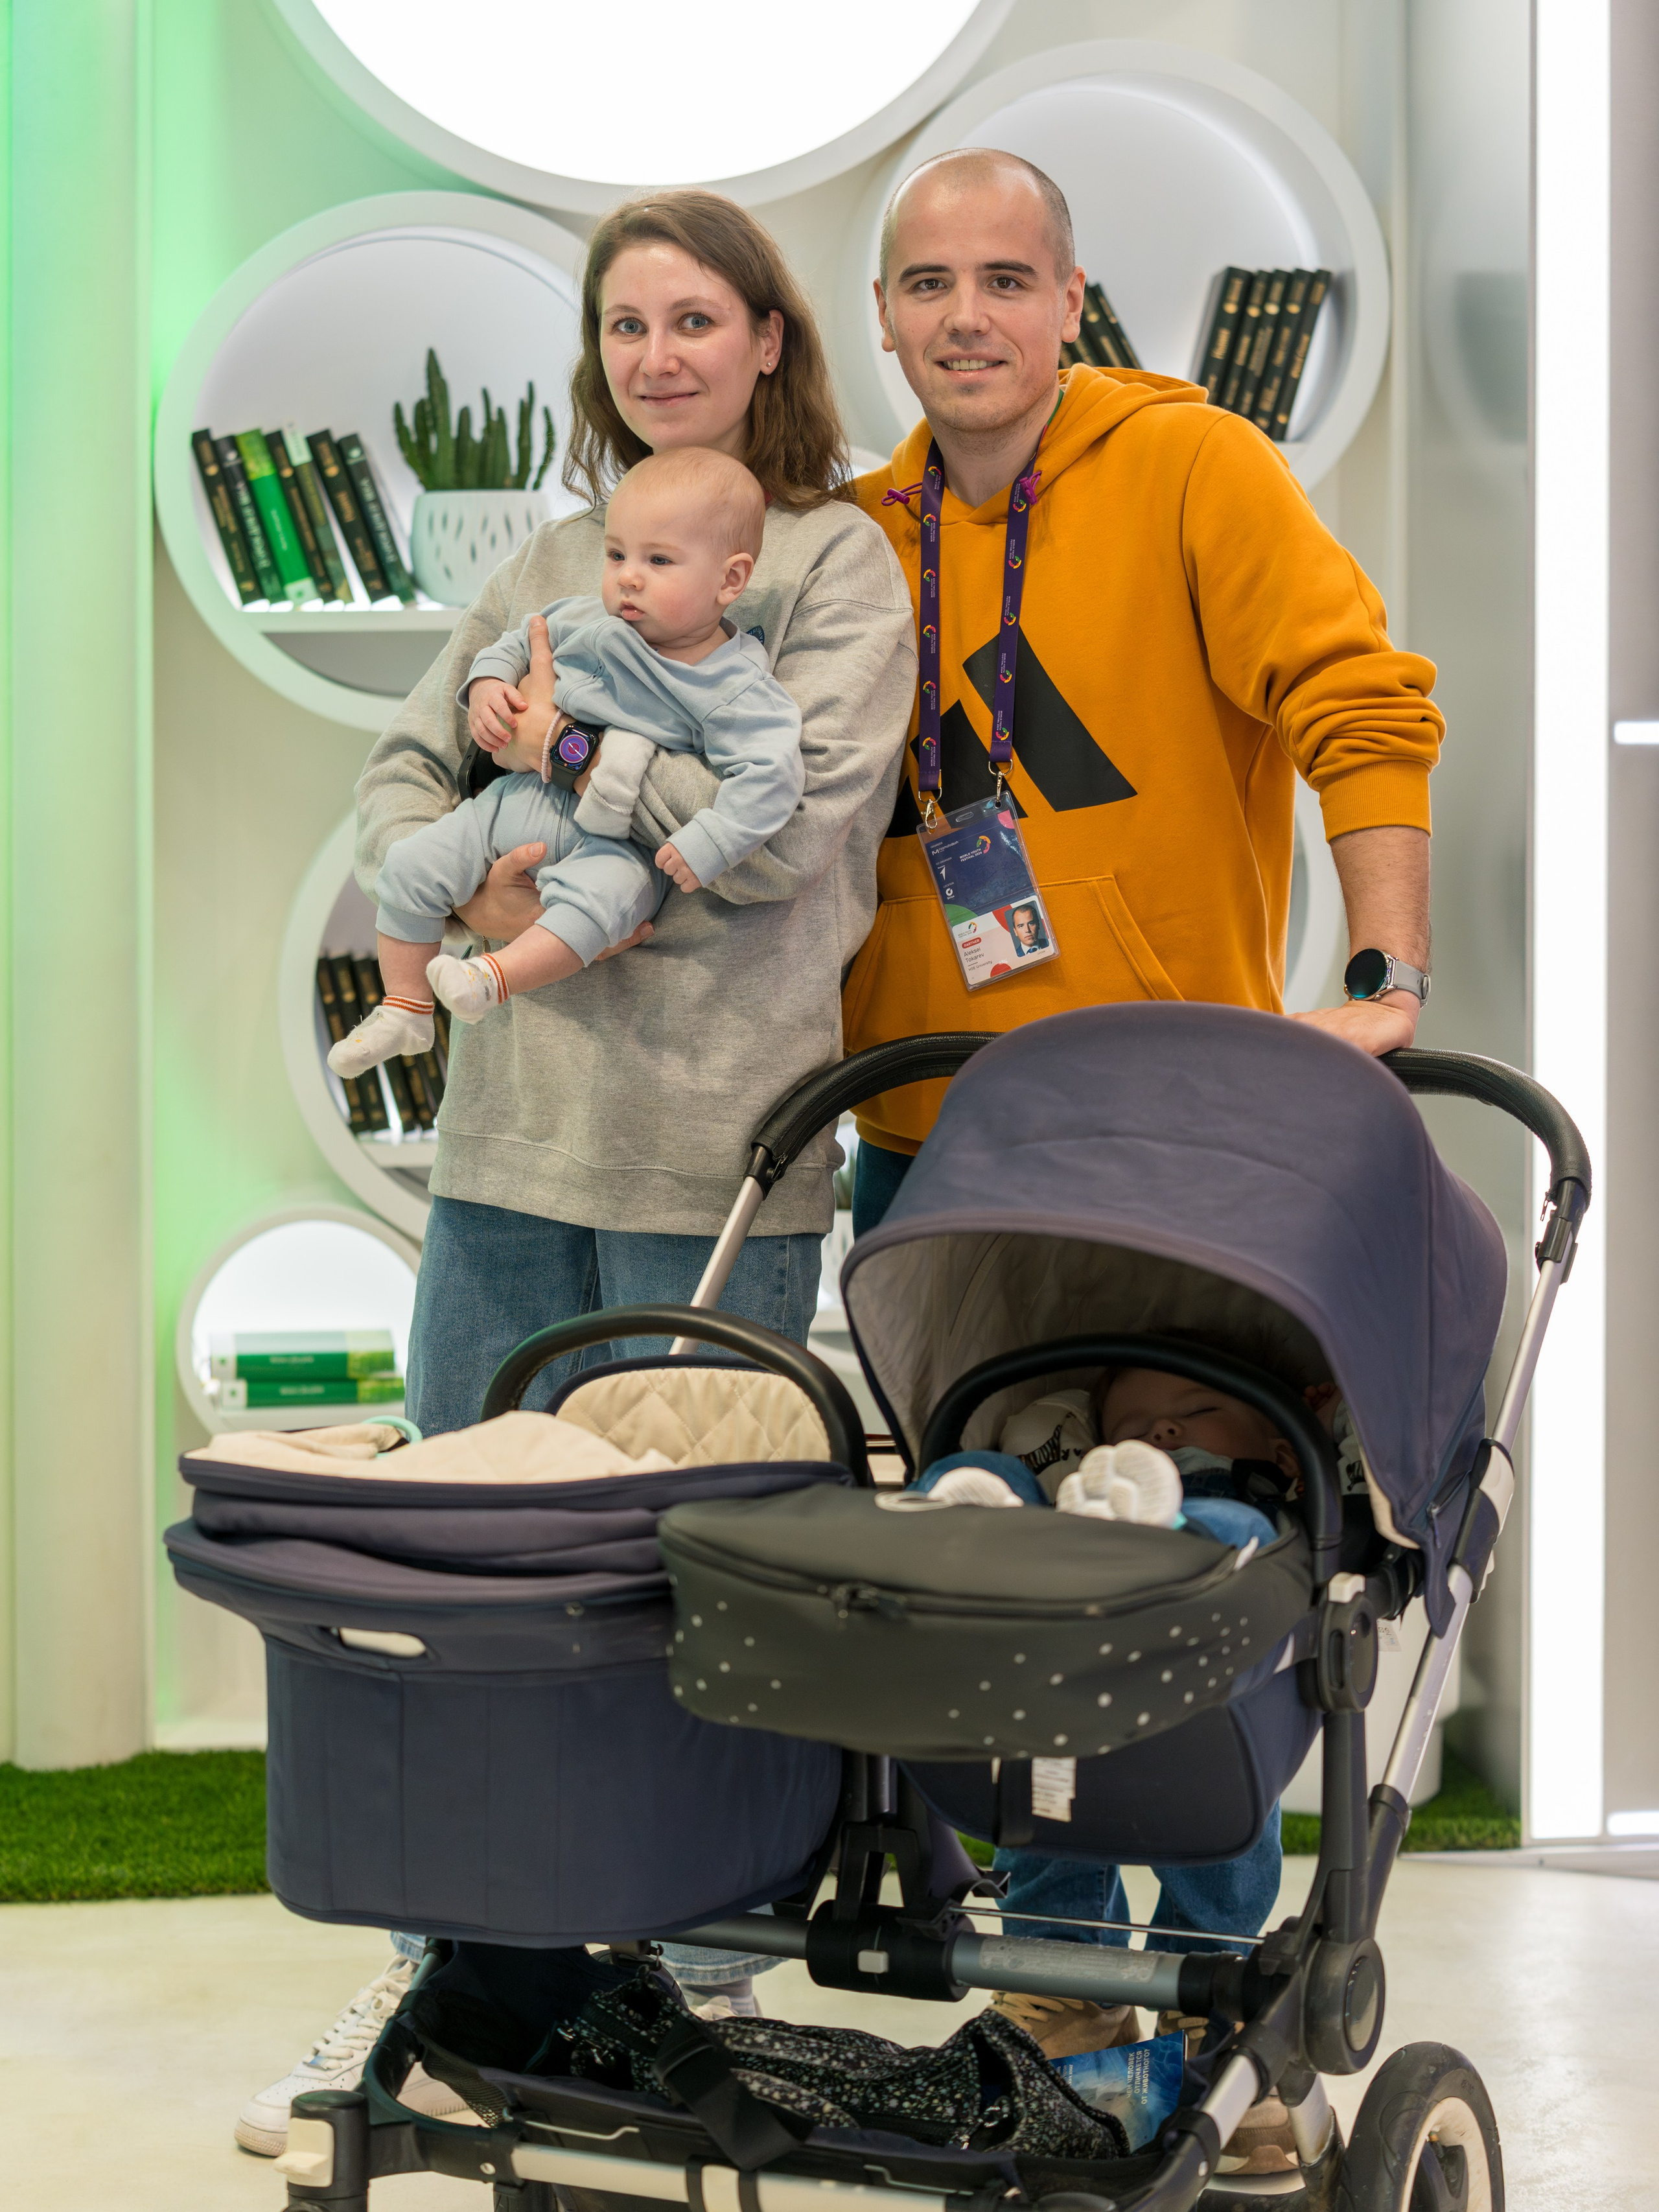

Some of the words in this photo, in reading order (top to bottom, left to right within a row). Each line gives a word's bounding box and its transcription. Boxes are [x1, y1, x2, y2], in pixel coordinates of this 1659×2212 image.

[964, 939, 980, 947] PARTNER
[964, 947, 981, 957] Aleksei
[965, 953, 984, 963] Tokarev
[1141, 2096, 1147, 2104] ОТ
